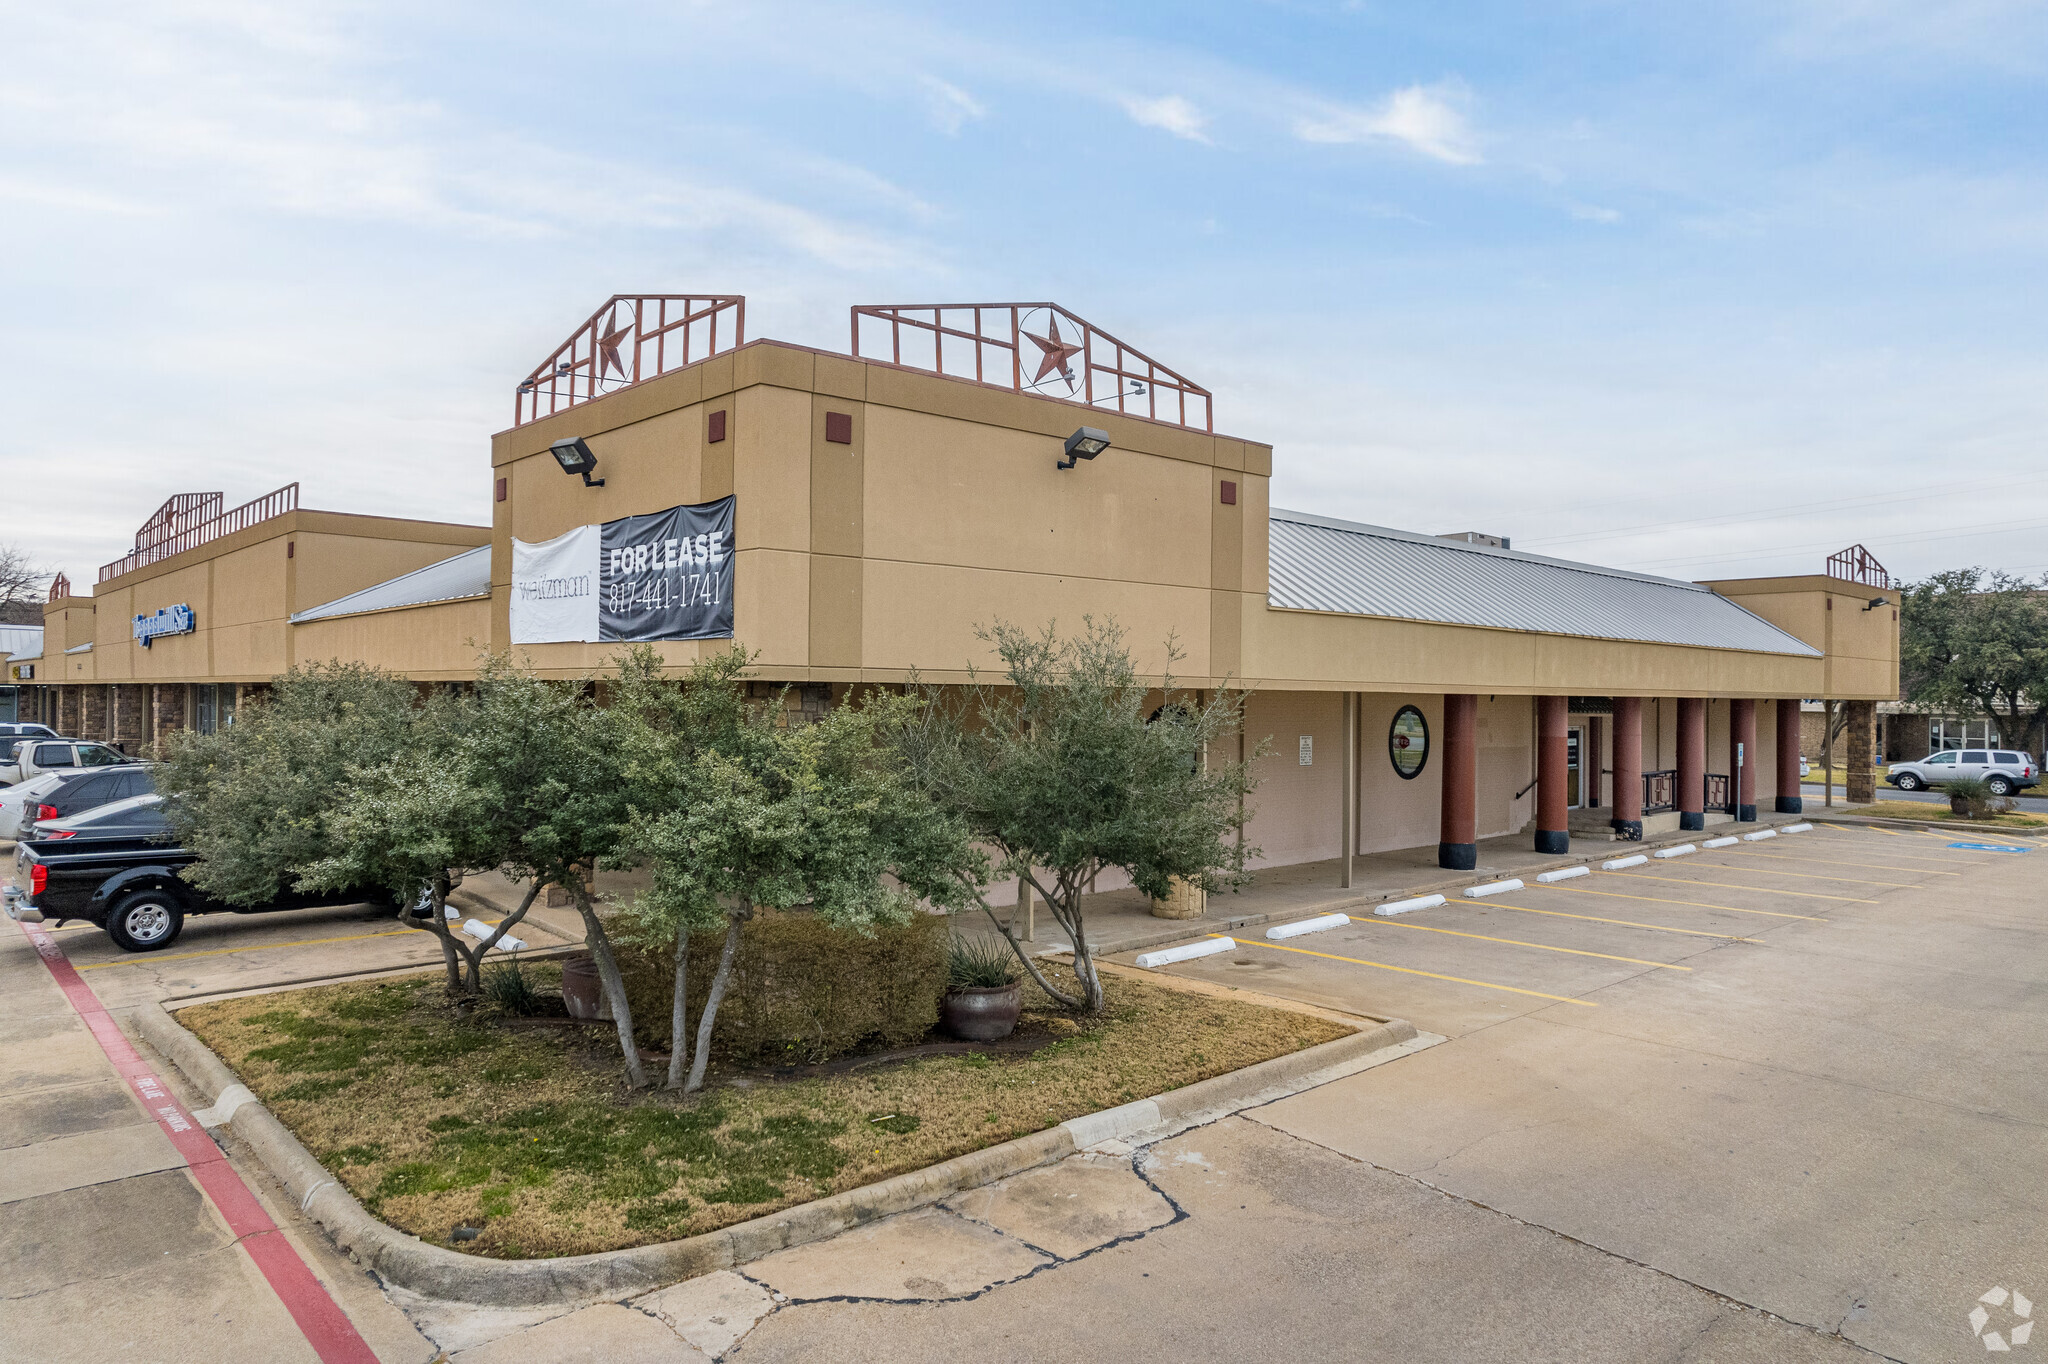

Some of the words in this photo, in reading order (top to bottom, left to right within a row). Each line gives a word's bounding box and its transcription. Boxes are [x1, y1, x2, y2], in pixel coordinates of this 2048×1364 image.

[610, 544, 648, 576] FOR
[652, 531, 724, 571] LEASE
[519, 573, 590, 600] weitzman
[609, 571, 720, 613] 817-441-1741
